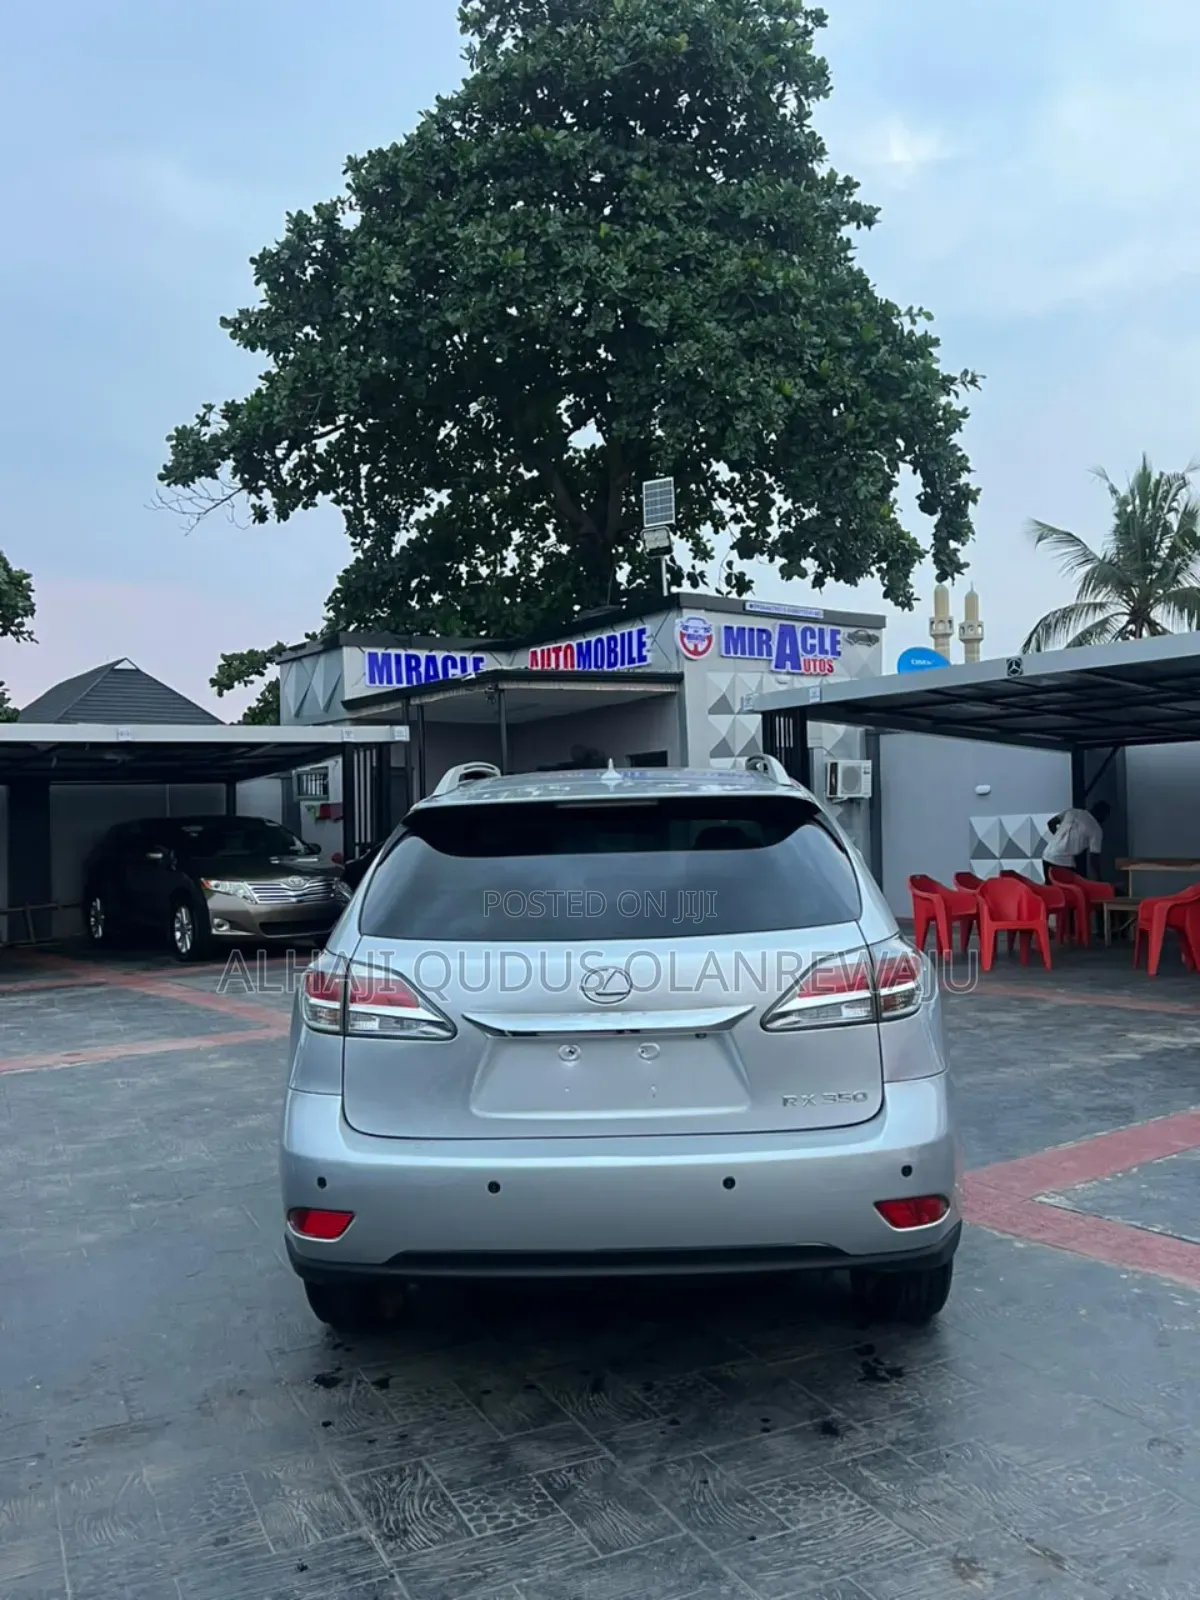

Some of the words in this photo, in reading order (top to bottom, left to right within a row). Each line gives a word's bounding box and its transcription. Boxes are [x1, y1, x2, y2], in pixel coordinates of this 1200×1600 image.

[723, 624, 842, 672] MIRACLE
[782, 1094, 816, 1107] RX
[821, 1091, 868, 1104] 350
